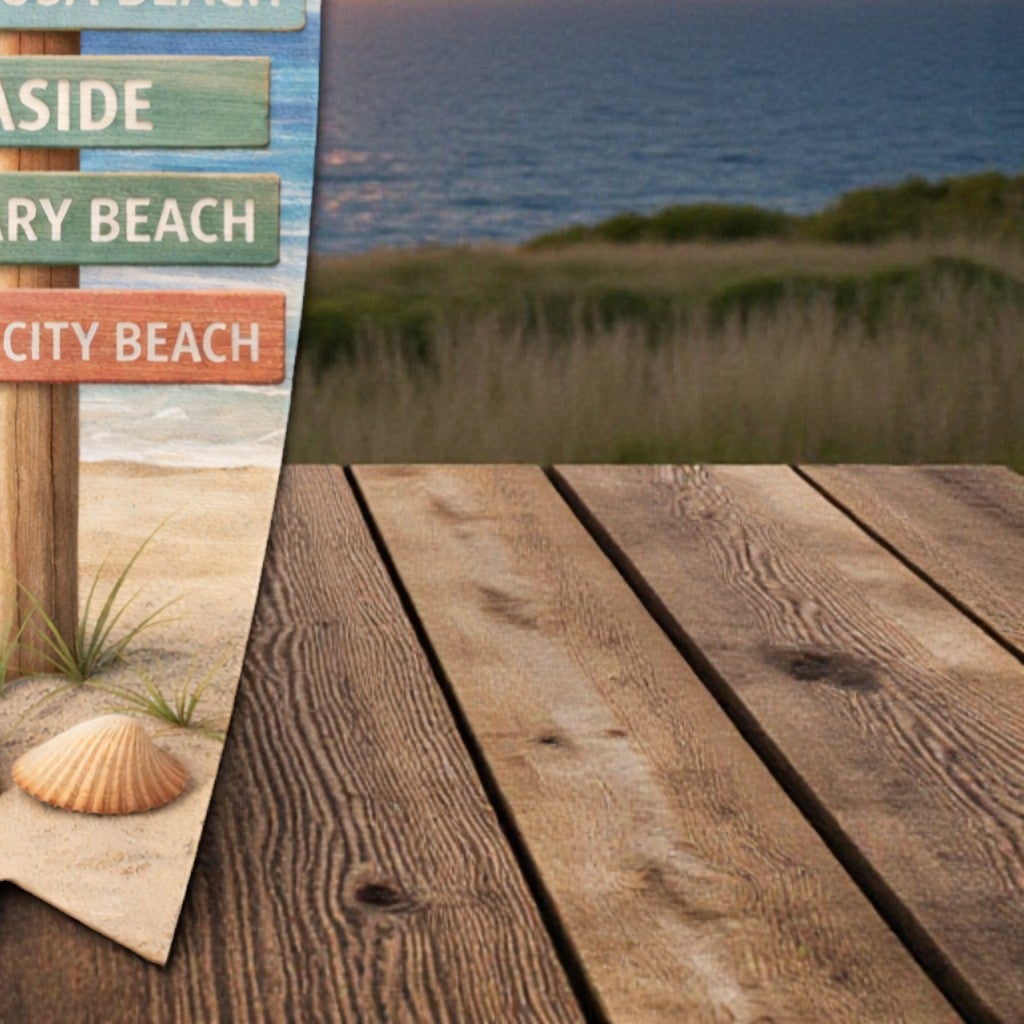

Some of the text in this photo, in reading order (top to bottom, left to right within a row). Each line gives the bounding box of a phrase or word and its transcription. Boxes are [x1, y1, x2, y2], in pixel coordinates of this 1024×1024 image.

[91, 197, 256, 244] BEACH
[3, 321, 101, 363] CITY
[115, 321, 261, 364] BEACH
